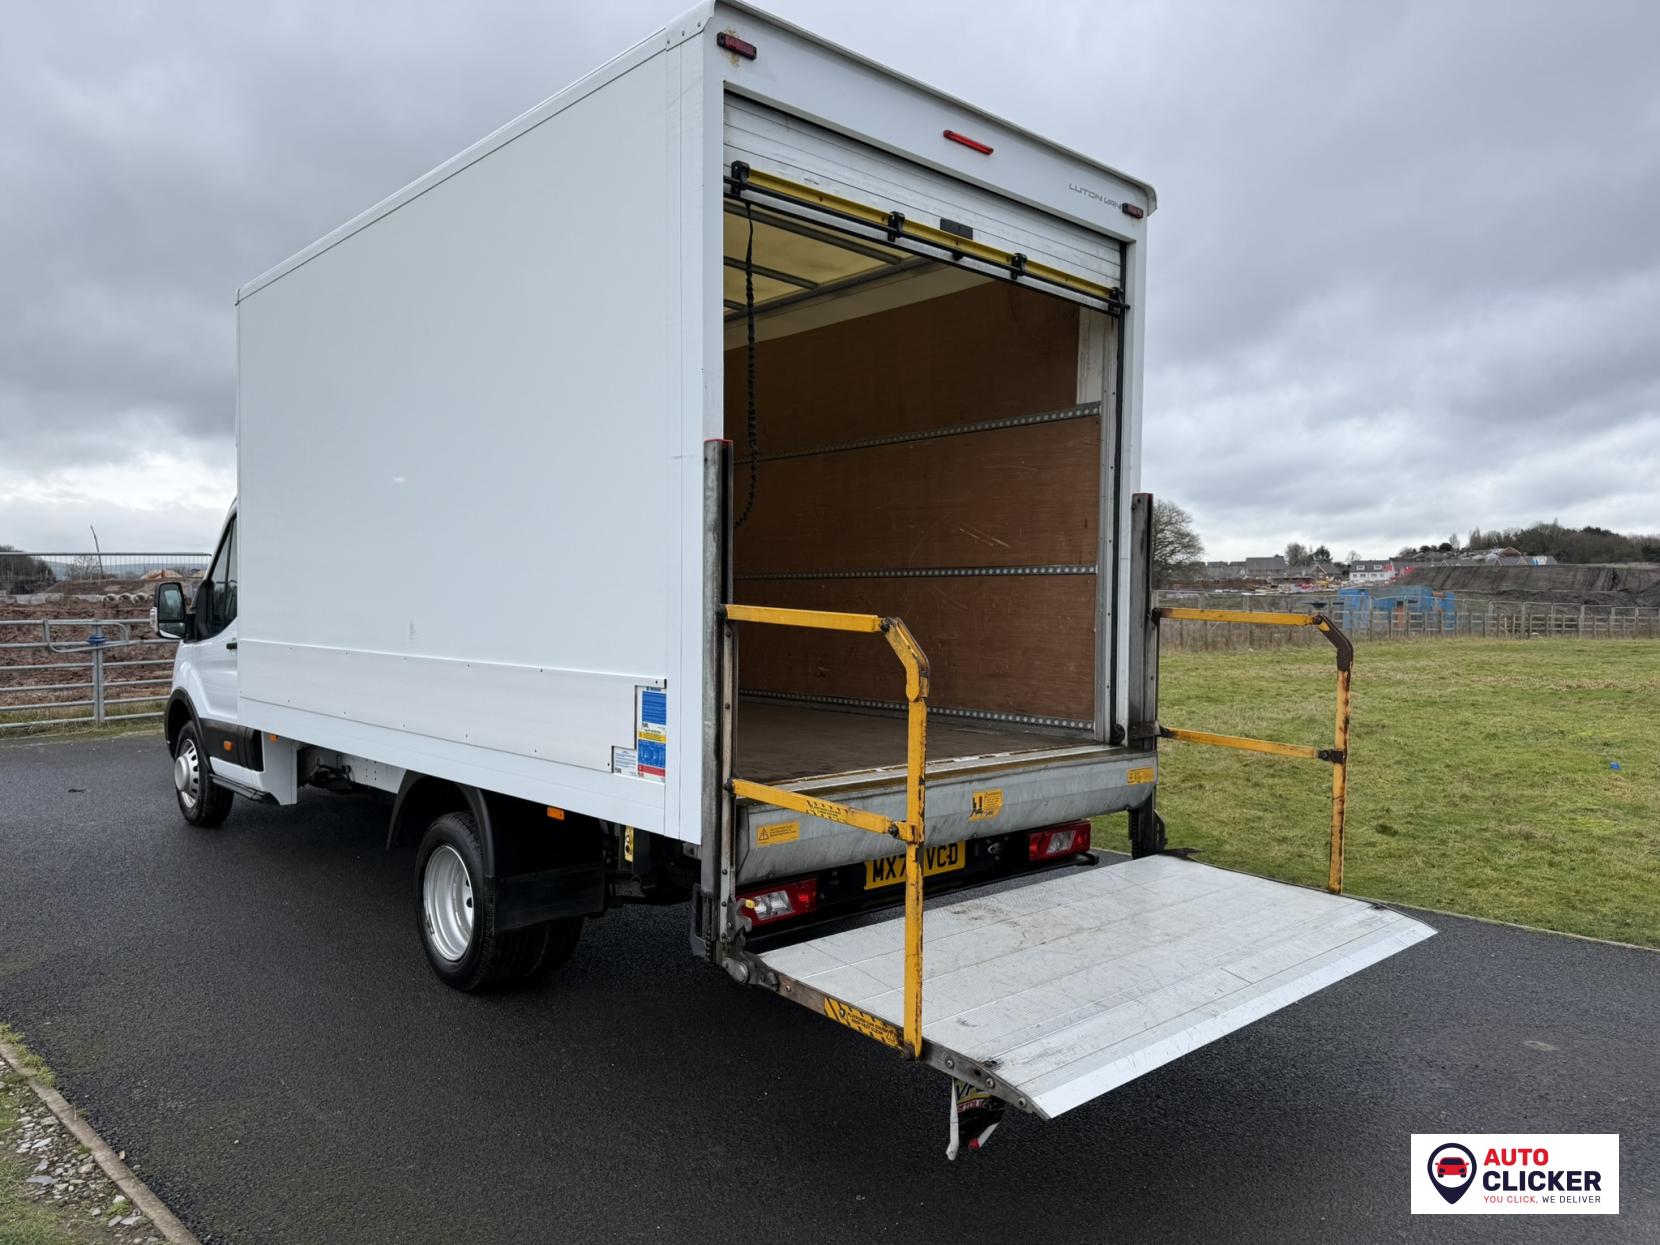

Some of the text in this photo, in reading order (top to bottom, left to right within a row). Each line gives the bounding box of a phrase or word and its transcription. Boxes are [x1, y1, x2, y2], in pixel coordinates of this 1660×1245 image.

[1069, 183, 1103, 201] LUTON
[873, 843, 958, 882] MX7 VCD
